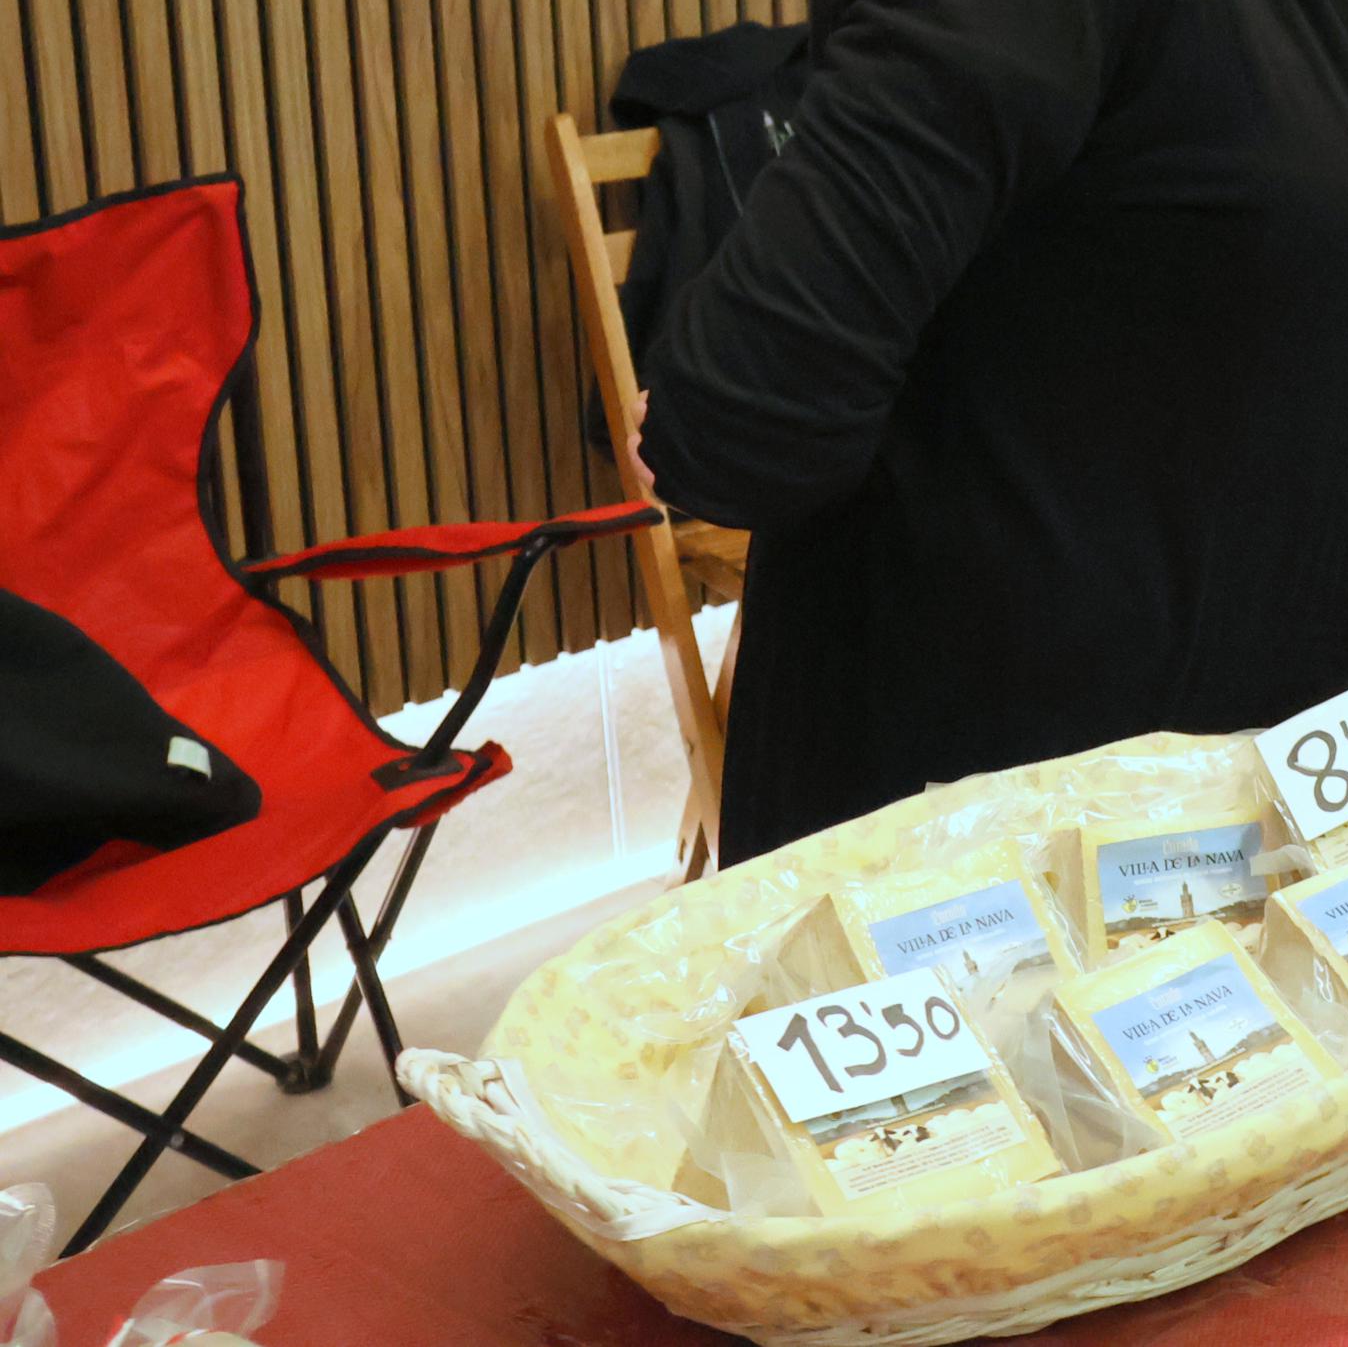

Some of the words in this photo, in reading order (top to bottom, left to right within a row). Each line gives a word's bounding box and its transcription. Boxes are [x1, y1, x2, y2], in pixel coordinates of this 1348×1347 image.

[1119, 860, 1160, 878] VILLA
[1205, 849, 1246, 866] NAVA
[897, 932, 938, 955] VILLA
[974, 908, 1016, 931] NAVA
[1122, 1018, 1162, 1041] VILLA
[1193, 983, 1234, 1009] NAVA
